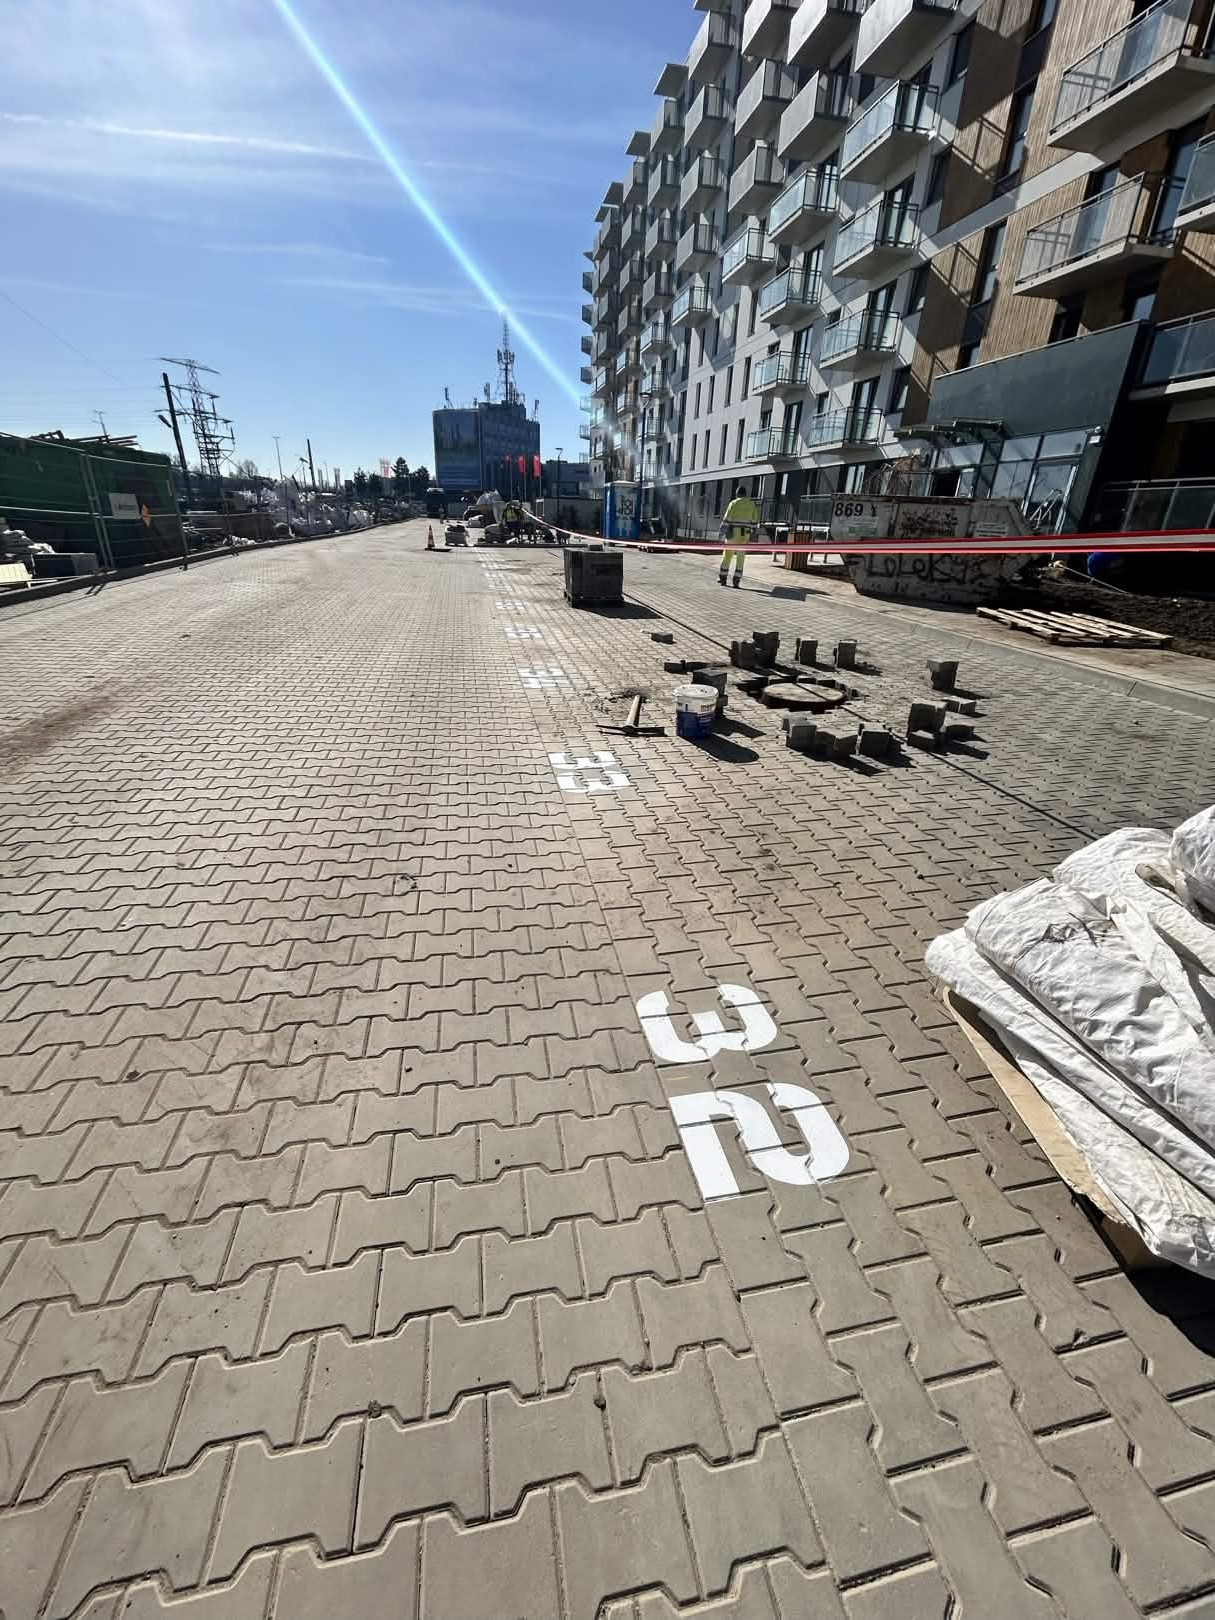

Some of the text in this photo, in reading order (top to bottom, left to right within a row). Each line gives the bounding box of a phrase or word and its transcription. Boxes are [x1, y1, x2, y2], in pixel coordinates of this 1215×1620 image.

[835, 502, 864, 517] 869
[547, 750, 632, 793] 33
[635, 983, 850, 1200] 32
